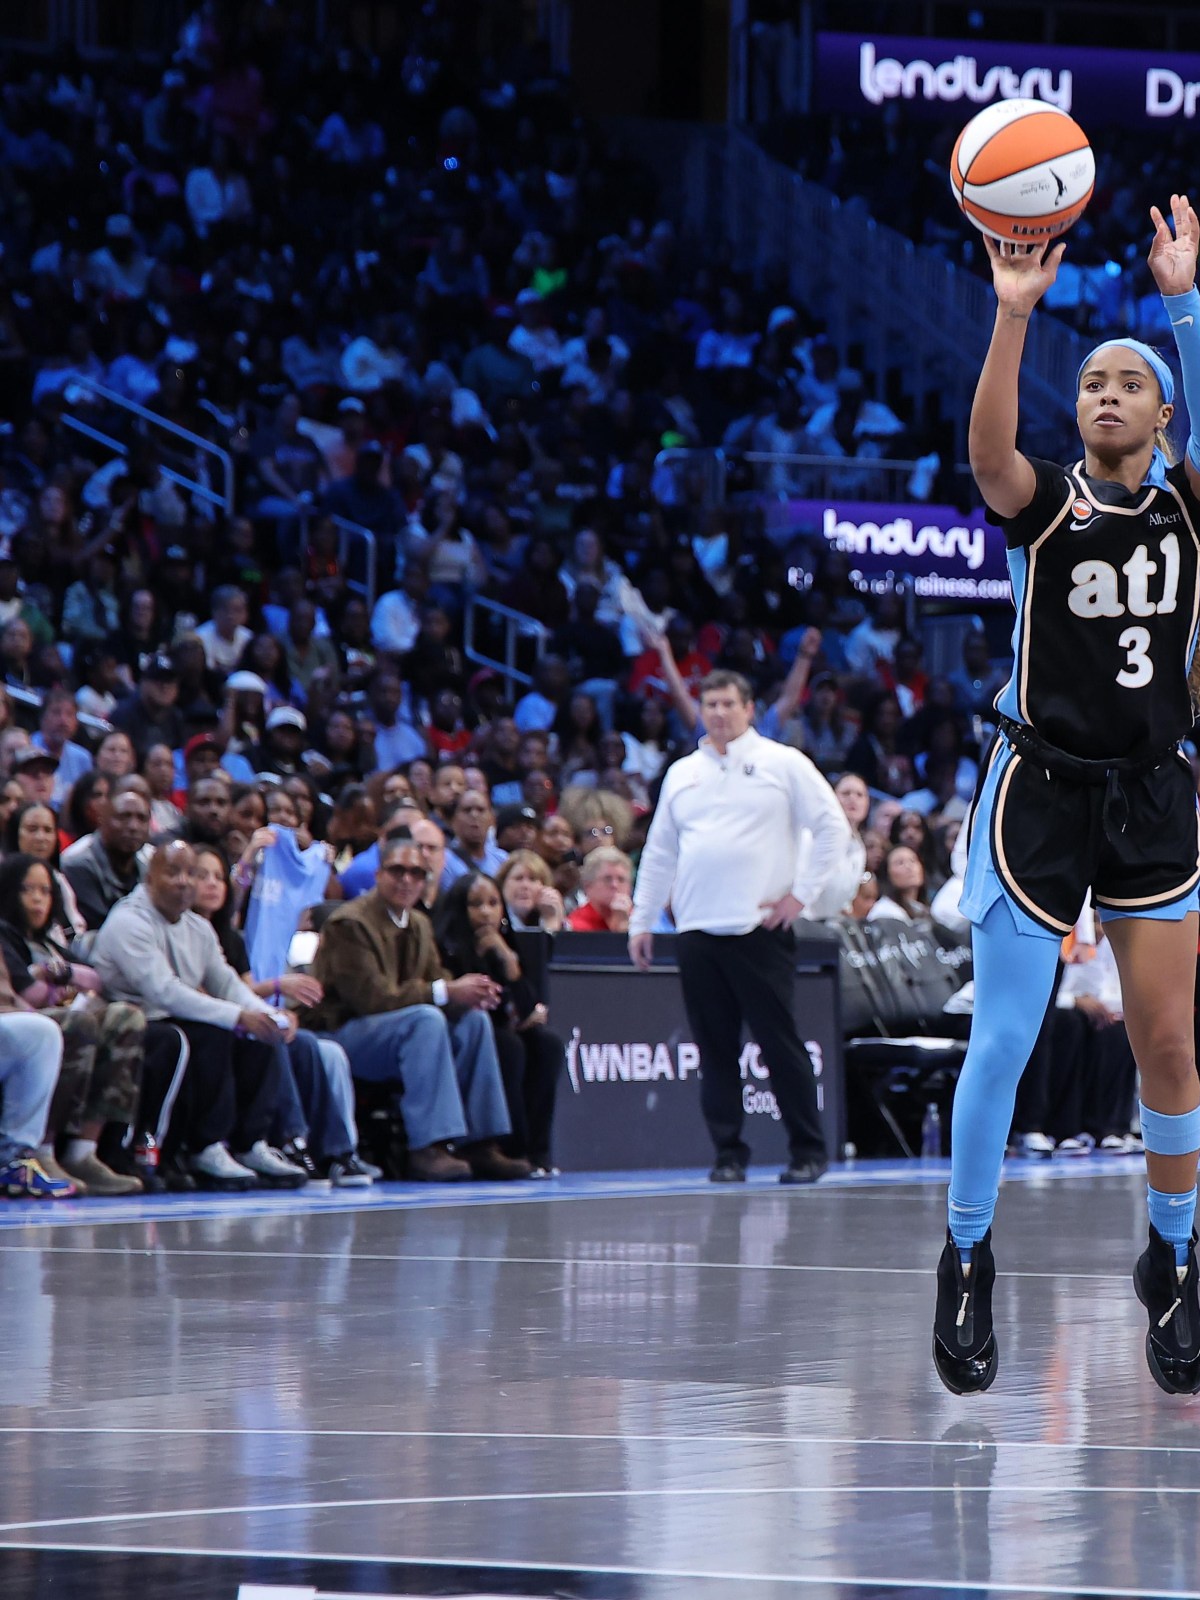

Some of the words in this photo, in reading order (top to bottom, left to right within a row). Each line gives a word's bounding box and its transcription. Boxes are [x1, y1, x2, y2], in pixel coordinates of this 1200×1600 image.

[1067, 532, 1181, 619] atl
[1115, 626, 1154, 689] 3
[579, 1043, 675, 1082] WNBA
